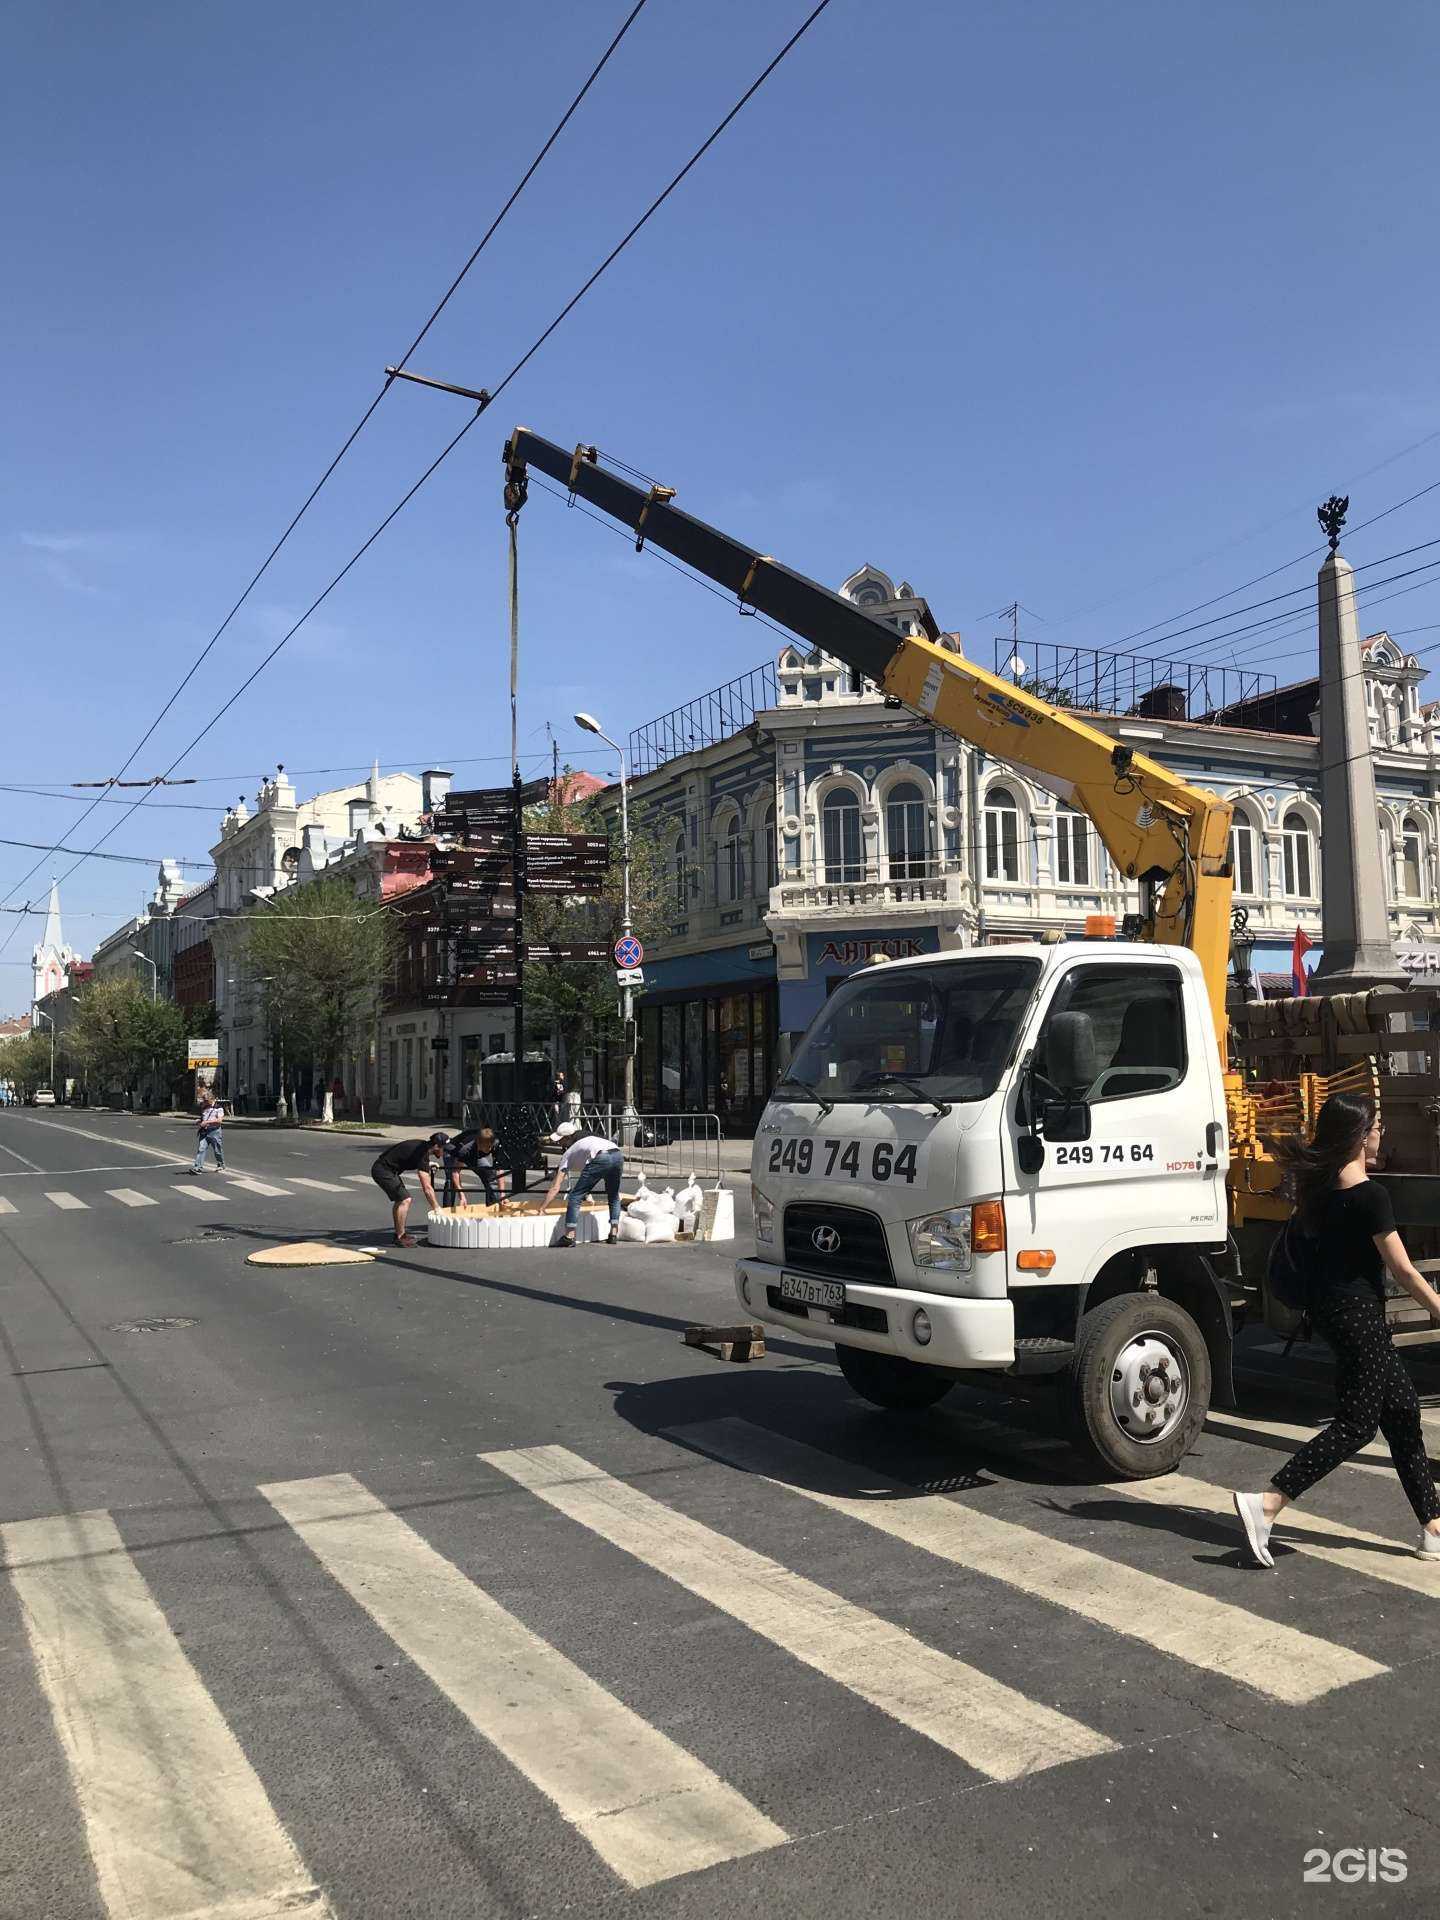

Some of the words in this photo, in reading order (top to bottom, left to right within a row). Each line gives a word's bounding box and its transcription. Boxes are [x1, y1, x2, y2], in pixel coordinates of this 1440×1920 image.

[769, 1138, 814, 1174] 249
[824, 1140, 860, 1178] 74
[872, 1143, 917, 1183] 64
[1056, 1146, 1093, 1164] 249
[1100, 1145, 1124, 1163] 74
[1131, 1144, 1153, 1161] 64
[1167, 1161, 1195, 1171] HD78
